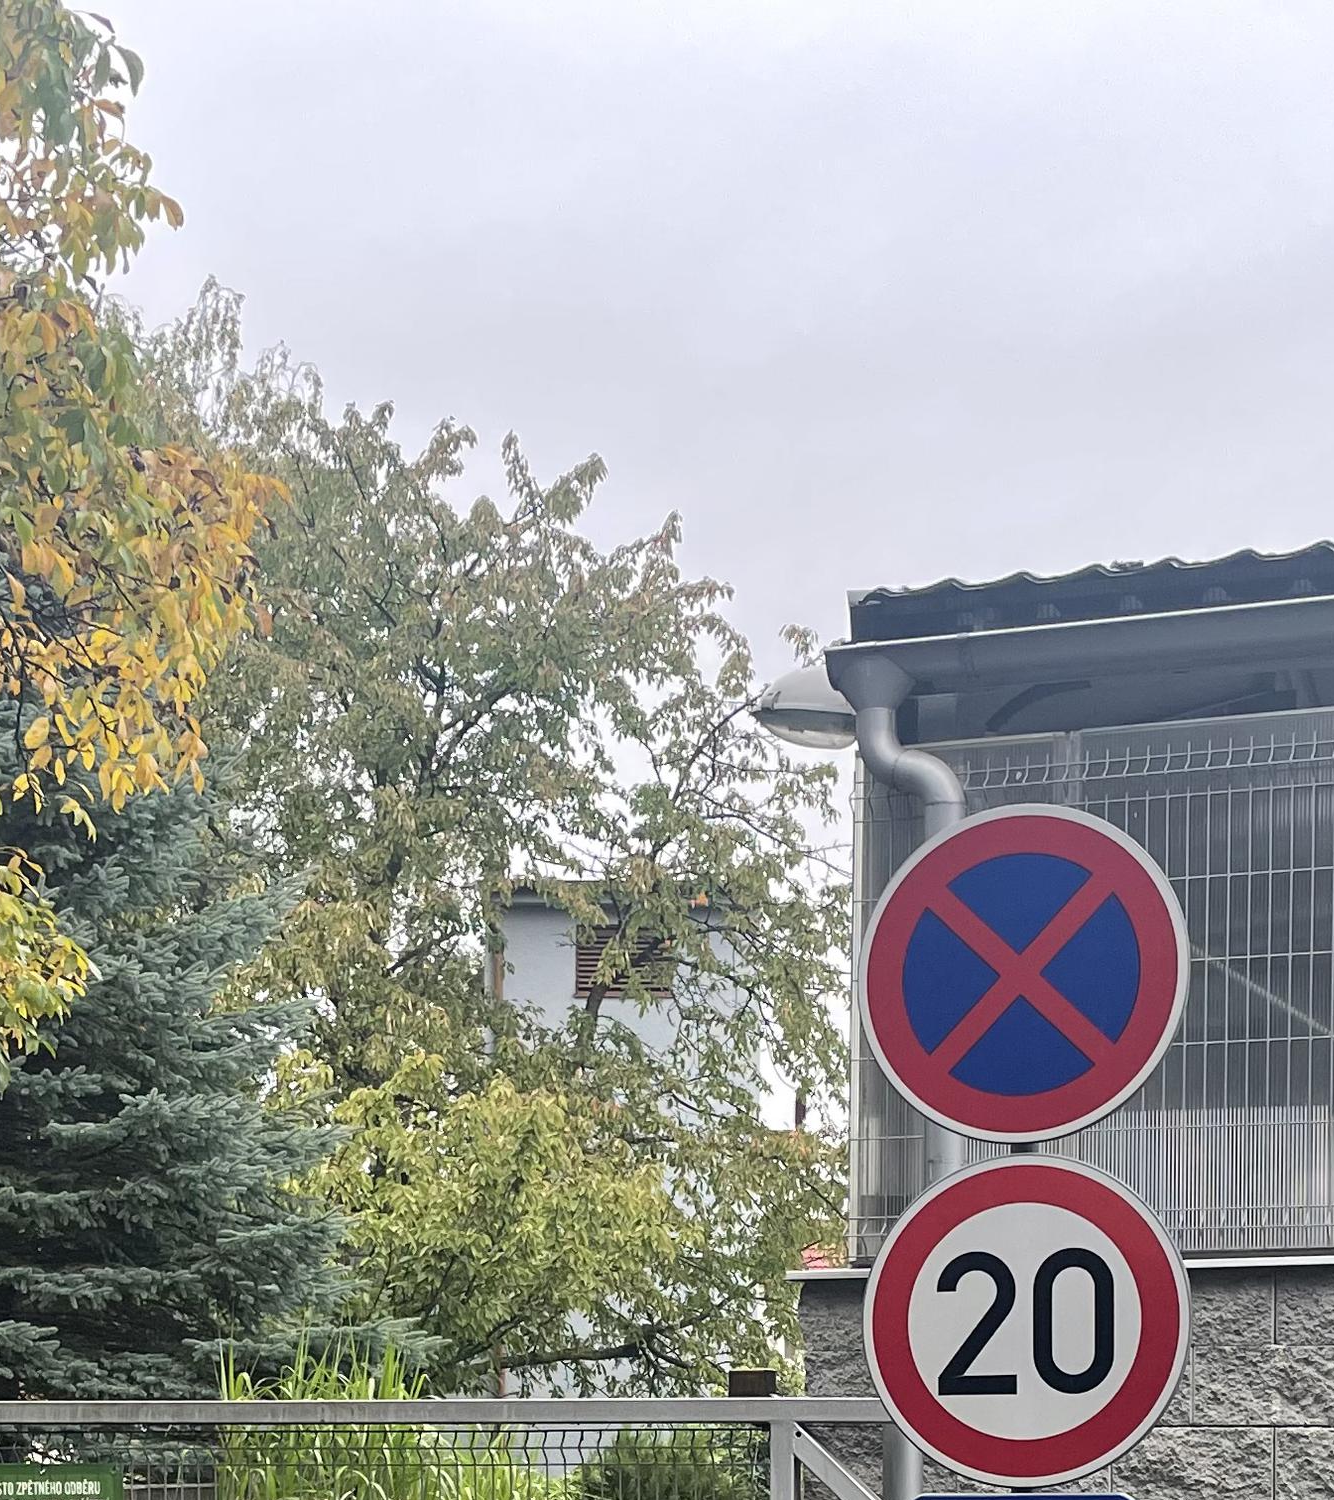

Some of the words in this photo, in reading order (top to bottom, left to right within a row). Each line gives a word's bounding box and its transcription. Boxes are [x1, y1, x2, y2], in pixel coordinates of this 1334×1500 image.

[936, 1247, 1114, 1396] 20
[15, 1480, 62, 1496] ZPĚTNÉHO
[64, 1479, 101, 1495] ODBĚRU
